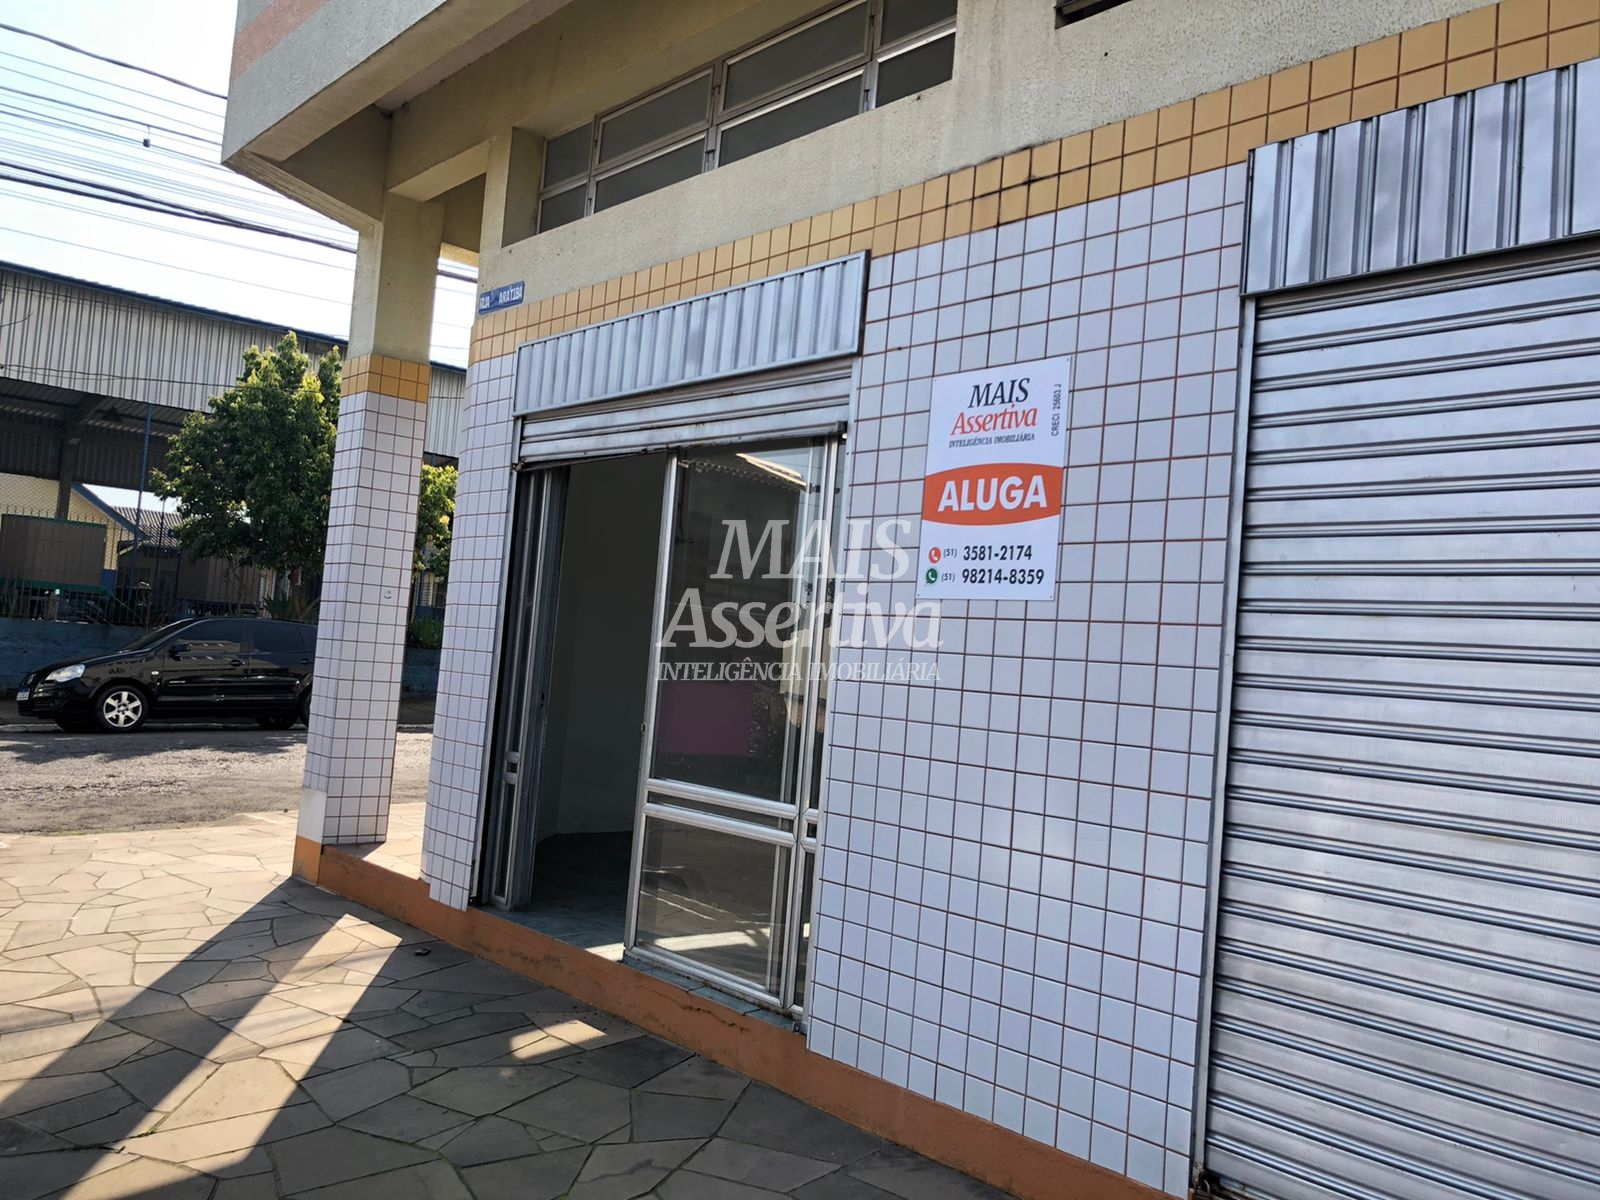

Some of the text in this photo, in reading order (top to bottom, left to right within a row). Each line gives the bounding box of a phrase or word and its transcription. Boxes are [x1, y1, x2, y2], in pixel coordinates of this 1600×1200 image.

[480, 296, 490, 308] RUA
[968, 377, 1030, 408] MAIS
[950, 403, 1038, 435] Assertiva
[1051, 413, 1060, 436] CRECI
[948, 432, 1035, 448] INTELIGÊNCIA IMOBILIÁRIA
[937, 474, 1047, 512] ALUGA
[943, 545, 1032, 560] (51) 3581-2174
[941, 568, 1044, 584] (51) 98214-8359
